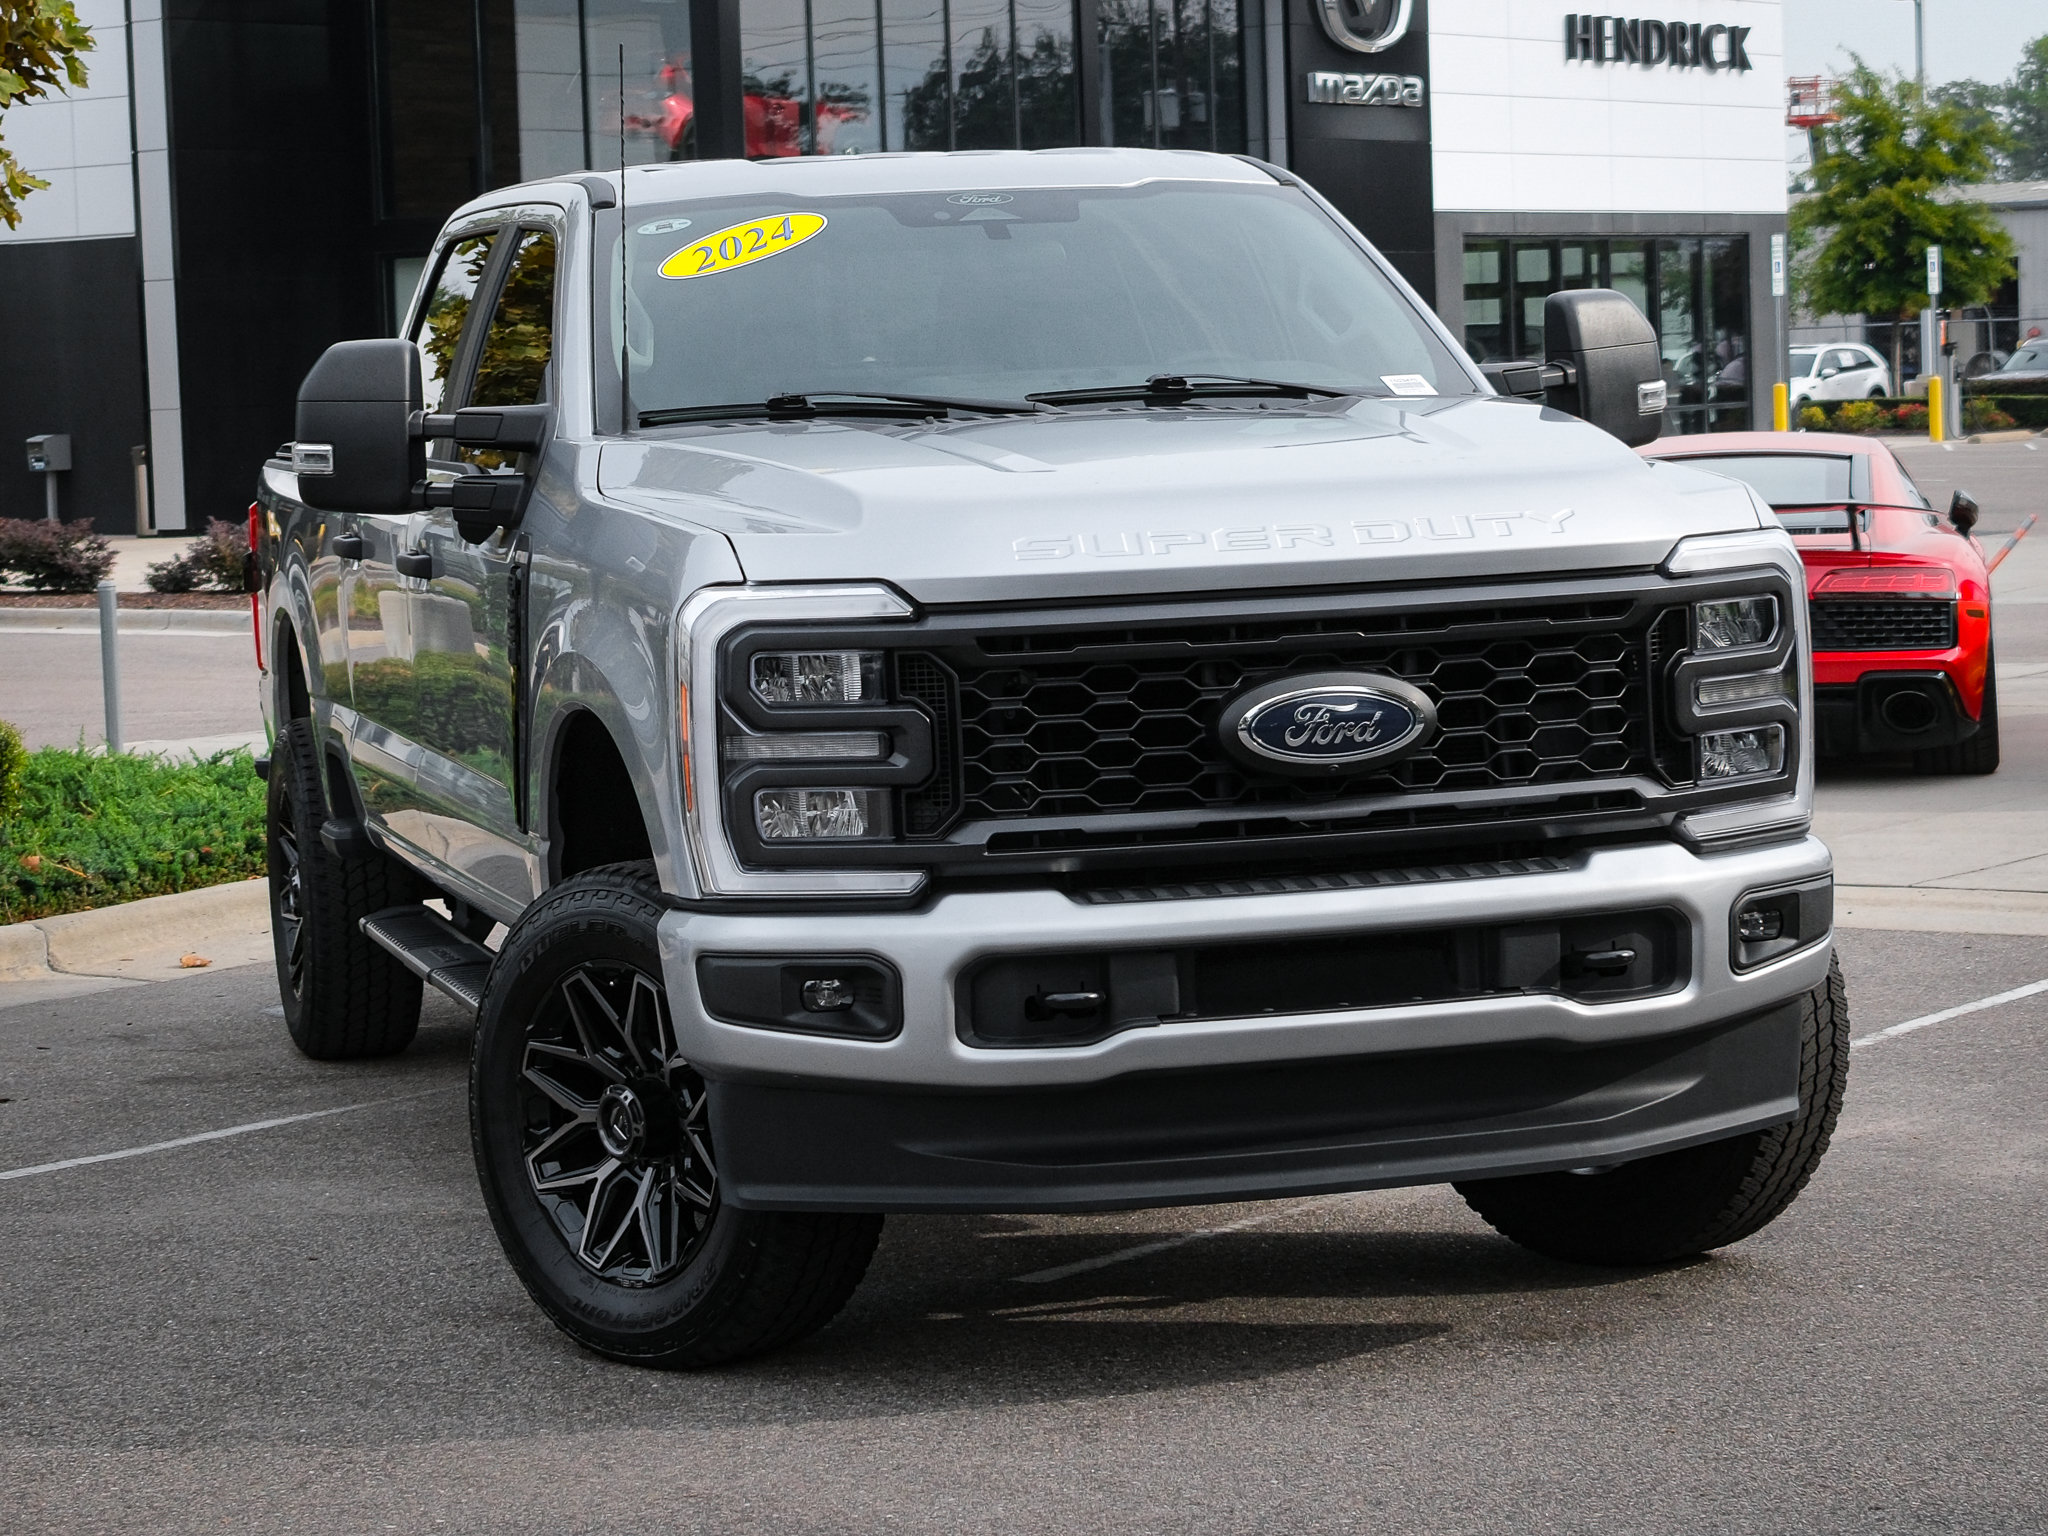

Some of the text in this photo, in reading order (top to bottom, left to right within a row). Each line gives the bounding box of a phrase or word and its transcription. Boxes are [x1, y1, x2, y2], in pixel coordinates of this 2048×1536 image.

[1565, 13, 1752, 70] HENDRICK
[960, 192, 1002, 204] Ford
[692, 216, 794, 273] 2024
[1012, 507, 1576, 562] SUPER DUTY
[1284, 702, 1383, 747] Ford
